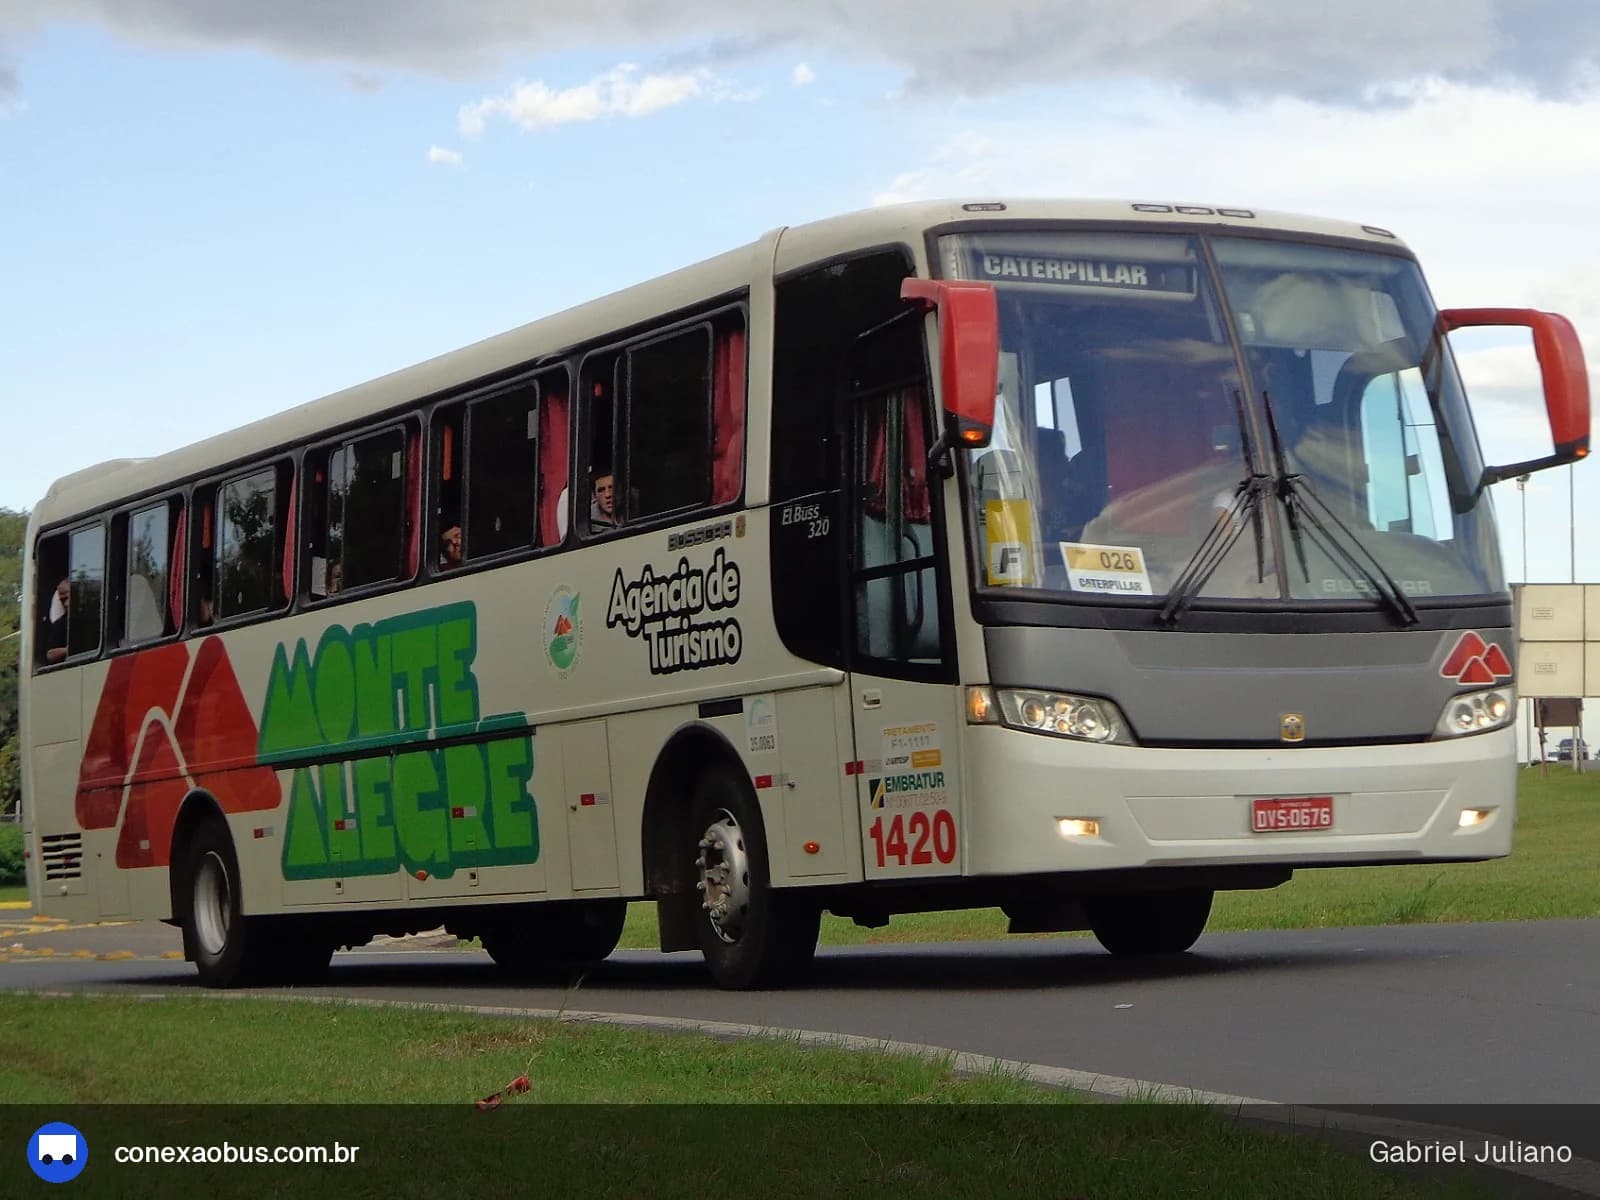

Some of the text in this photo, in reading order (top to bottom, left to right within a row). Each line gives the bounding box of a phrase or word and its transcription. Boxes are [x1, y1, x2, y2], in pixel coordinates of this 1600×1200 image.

[984, 255, 1148, 286] CATERPILLAR
[807, 517, 830, 539] 320
[1099, 551, 1136, 570] 026
[607, 558, 704, 636] Agência
[706, 548, 740, 611] de
[1079, 577, 1143, 592] CATERPILLAR
[643, 617, 742, 674] Turismo
[257, 600, 480, 764] MONTE
[281, 712, 540, 880] ALEGRE
[885, 771, 945, 793] EMBRATUR
[869, 809, 957, 868] 1420
